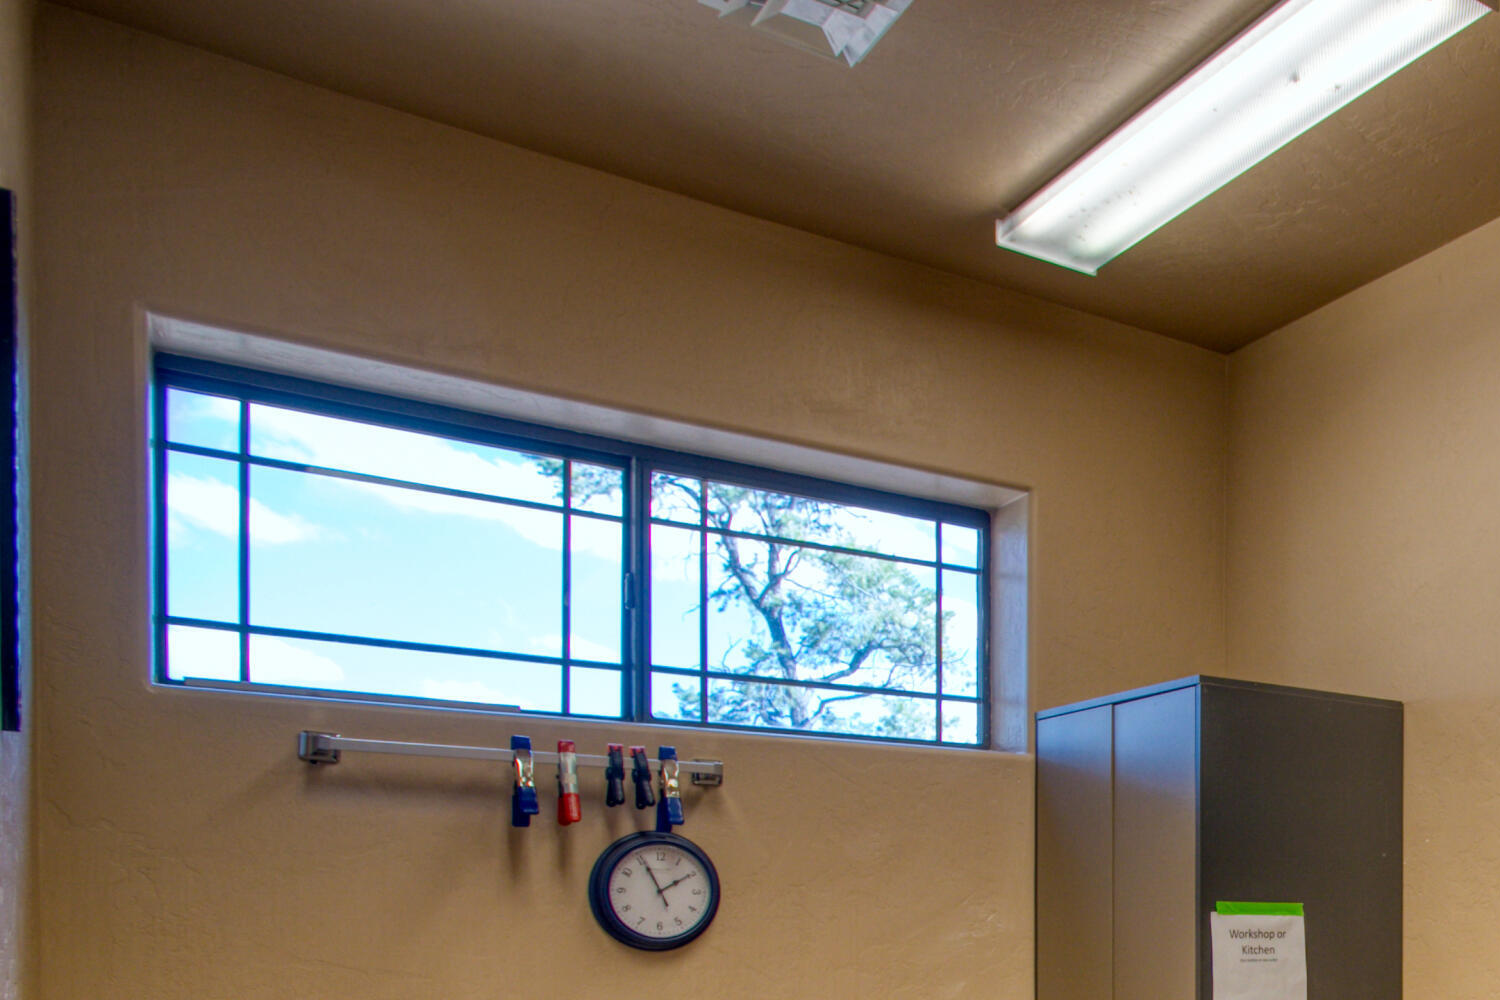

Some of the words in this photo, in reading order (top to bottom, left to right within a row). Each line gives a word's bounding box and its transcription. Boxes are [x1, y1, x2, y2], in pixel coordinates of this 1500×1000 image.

[656, 852, 666, 861] 12
[675, 858, 681, 866] 1
[622, 868, 632, 877] 10
[622, 904, 631, 912] 8
[637, 917, 646, 925] 7
[674, 917, 683, 926] 5
[657, 922, 663, 931] 6
[1229, 929, 1275, 940] Workshop
[1277, 931, 1286, 939] or
[1242, 945, 1275, 955] Kitchen
